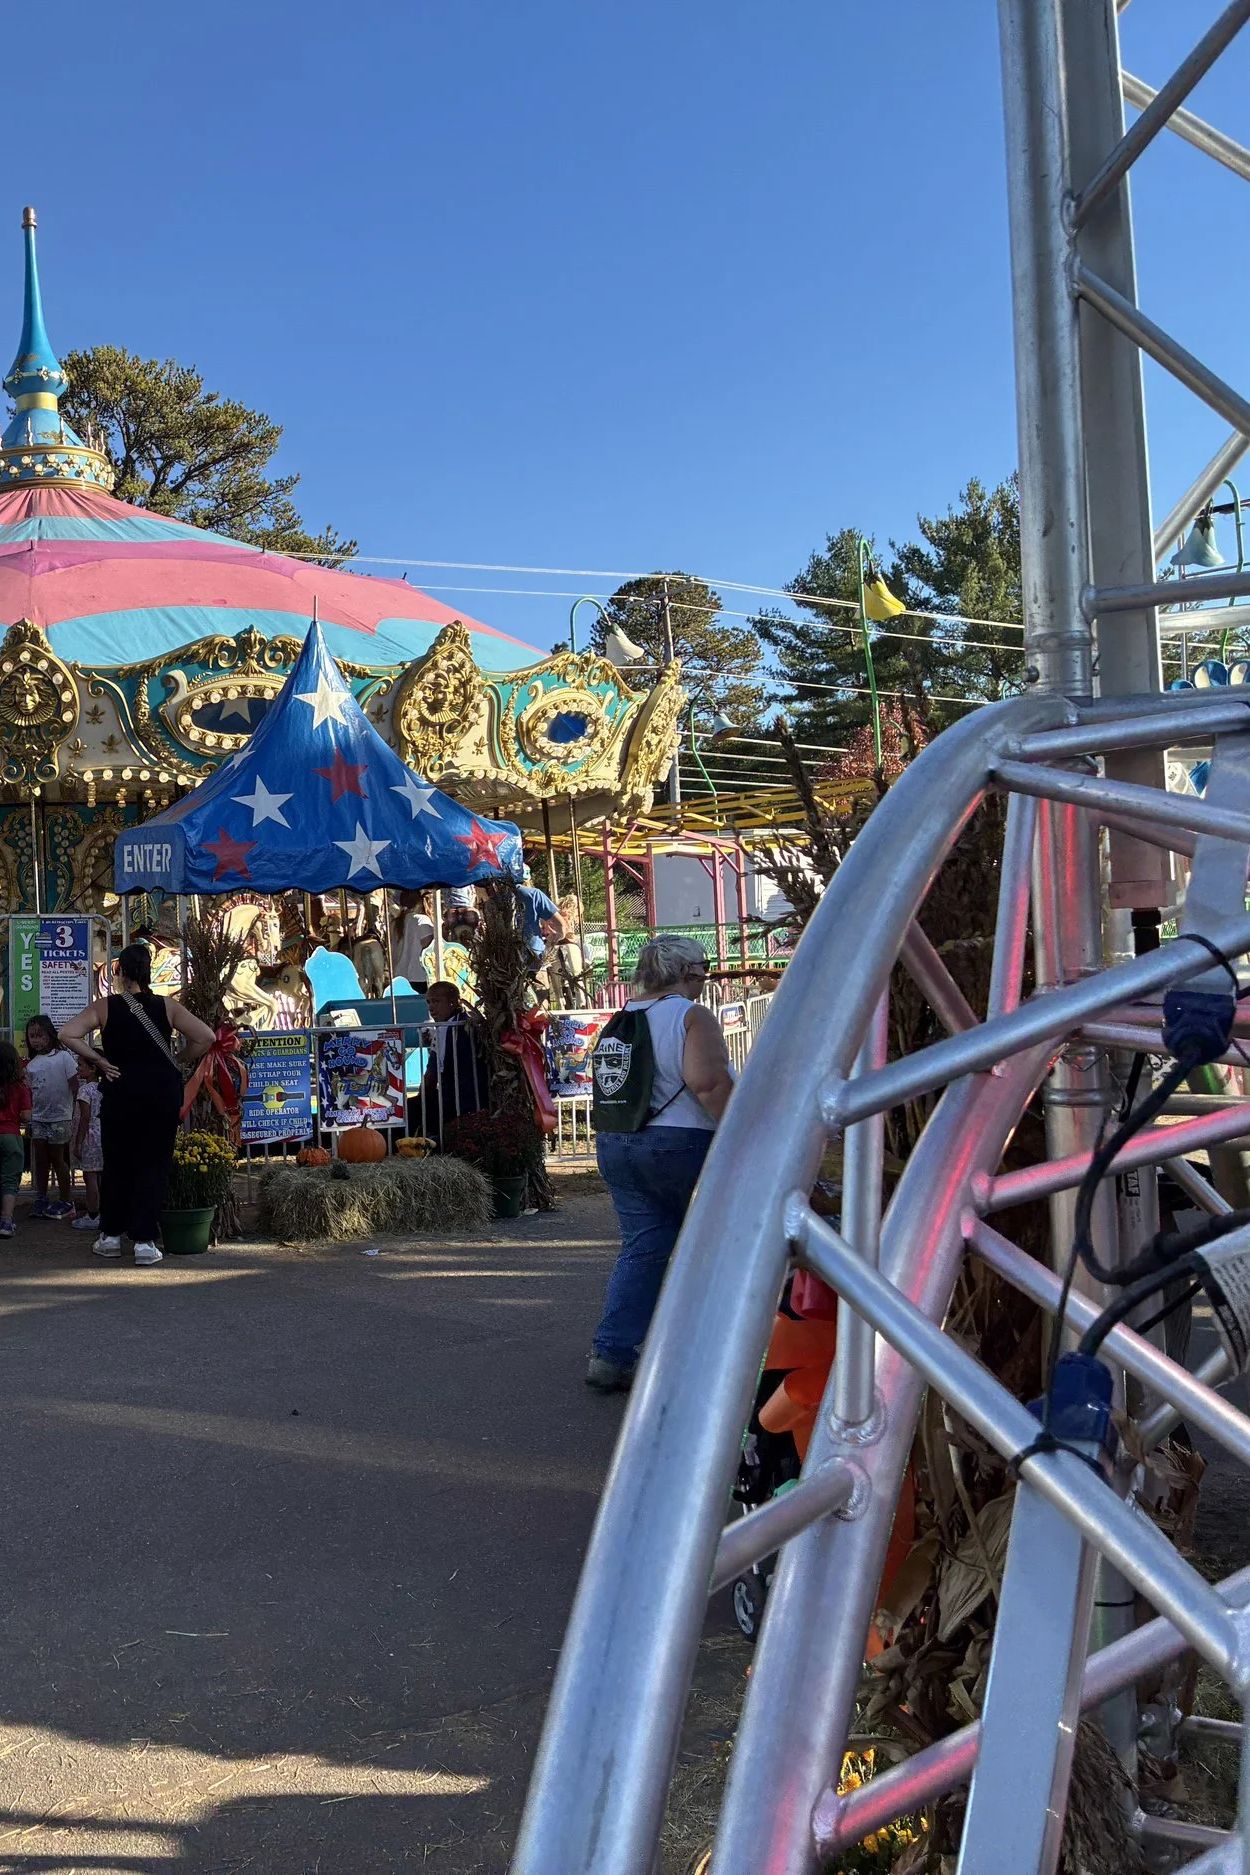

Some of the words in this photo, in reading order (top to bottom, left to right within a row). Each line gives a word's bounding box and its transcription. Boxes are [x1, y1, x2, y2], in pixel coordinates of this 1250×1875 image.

[123, 843, 172, 873] ENTER
[55, 925, 74, 949] 3
[42, 949, 86, 958] TICKETS
[246, 1036, 301, 1048] TENTION
[323, 1037, 371, 1051] MERRY
[272, 1048, 308, 1056] GUARDIANS
[337, 1045, 357, 1057] GO
[599, 1042, 625, 1054] AINE
[266, 1061, 287, 1069] MAKE
[288, 1060, 307, 1068] SURE
[327, 1055, 369, 1069] ROUND
[258, 1070, 281, 1078] STRAP
[282, 1069, 301, 1077] YOUR
[280, 1079, 299, 1087] SEAT
[248, 1109, 265, 1117] RIDE
[265, 1106, 300, 1116] OPERATOR
[241, 1120, 257, 1128] WILL
[258, 1118, 280, 1127] CHECK
[281, 1118, 288, 1126] IF
[288, 1117, 308, 1126] CHILD
[248, 1130, 277, 1139] SECURED
[278, 1128, 310, 1137] PROPERLY
